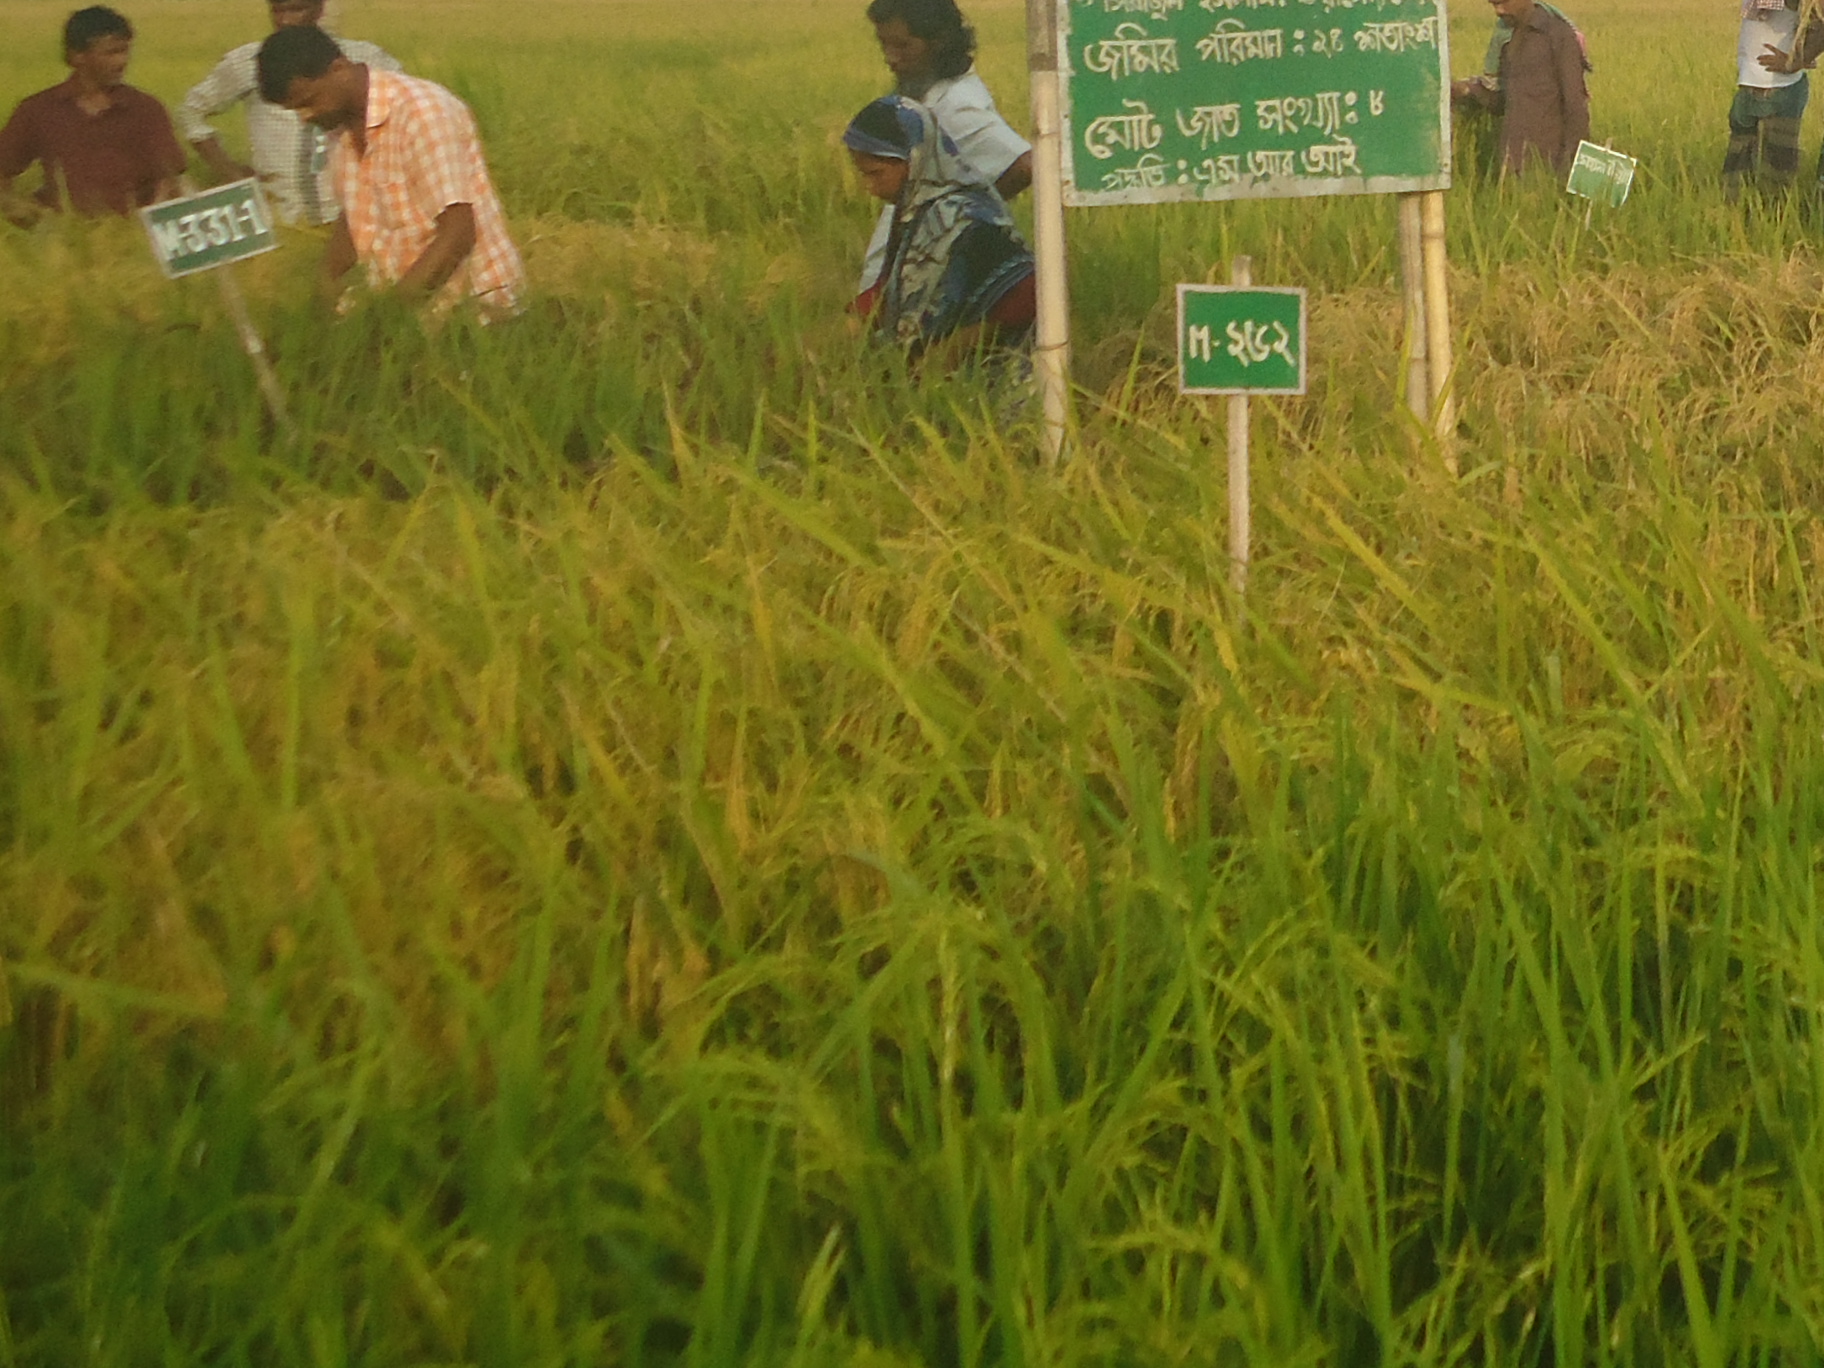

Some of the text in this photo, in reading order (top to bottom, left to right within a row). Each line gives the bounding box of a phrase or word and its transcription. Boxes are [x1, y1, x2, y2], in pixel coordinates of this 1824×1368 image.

[1084, 23, 1180, 81] জমির
[1312, 28, 1343, 59] ২৪
[1085, 98, 1162, 159] মোট
[1176, 103, 1241, 150] জাত
[1369, 89, 1384, 116] ৮
[1193, 155, 1240, 185] এস
[1247, 150, 1295, 177] আর
[1301, 133, 1362, 175] আই
